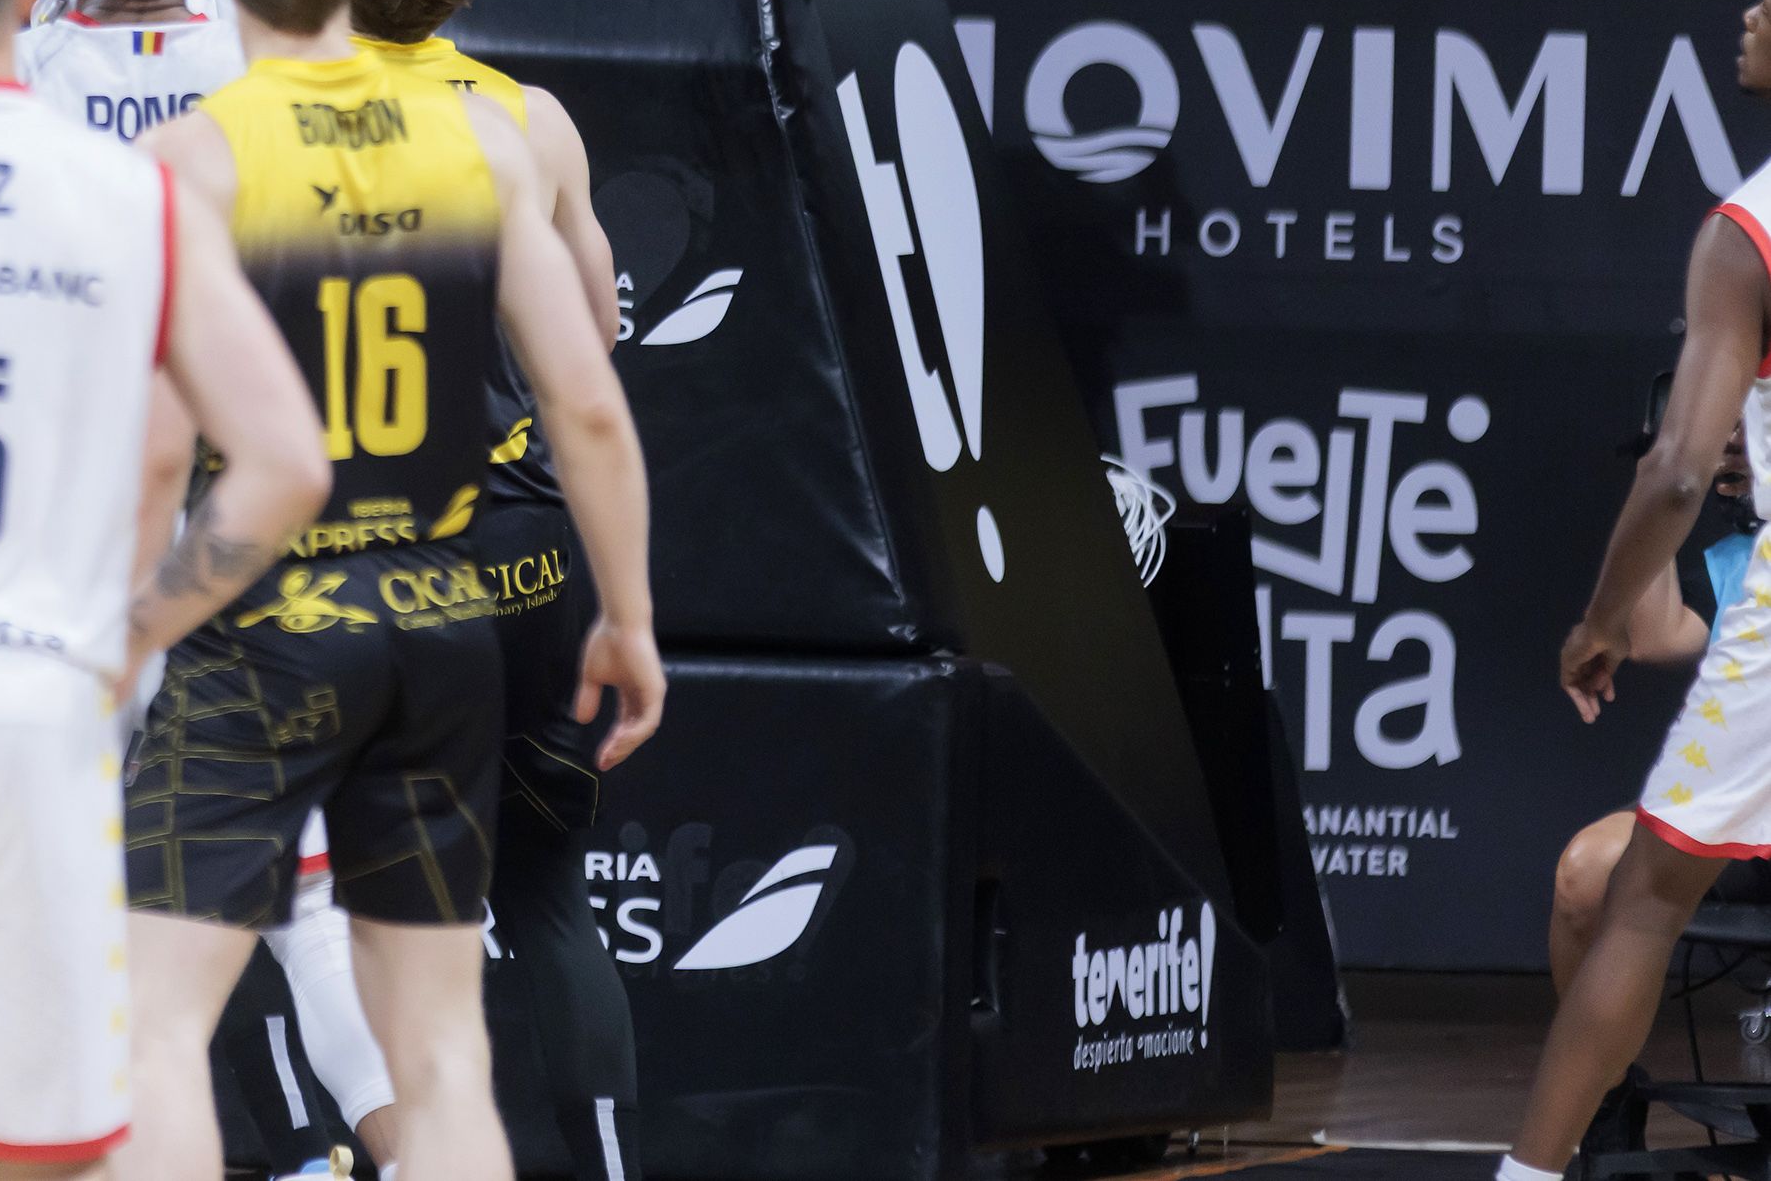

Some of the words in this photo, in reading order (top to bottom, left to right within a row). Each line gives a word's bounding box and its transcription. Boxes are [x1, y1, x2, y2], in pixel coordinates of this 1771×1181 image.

[1134, 208, 1465, 265] HOTELS
[317, 273, 428, 461] 16
[1073, 1030, 1135, 1074] despierta
